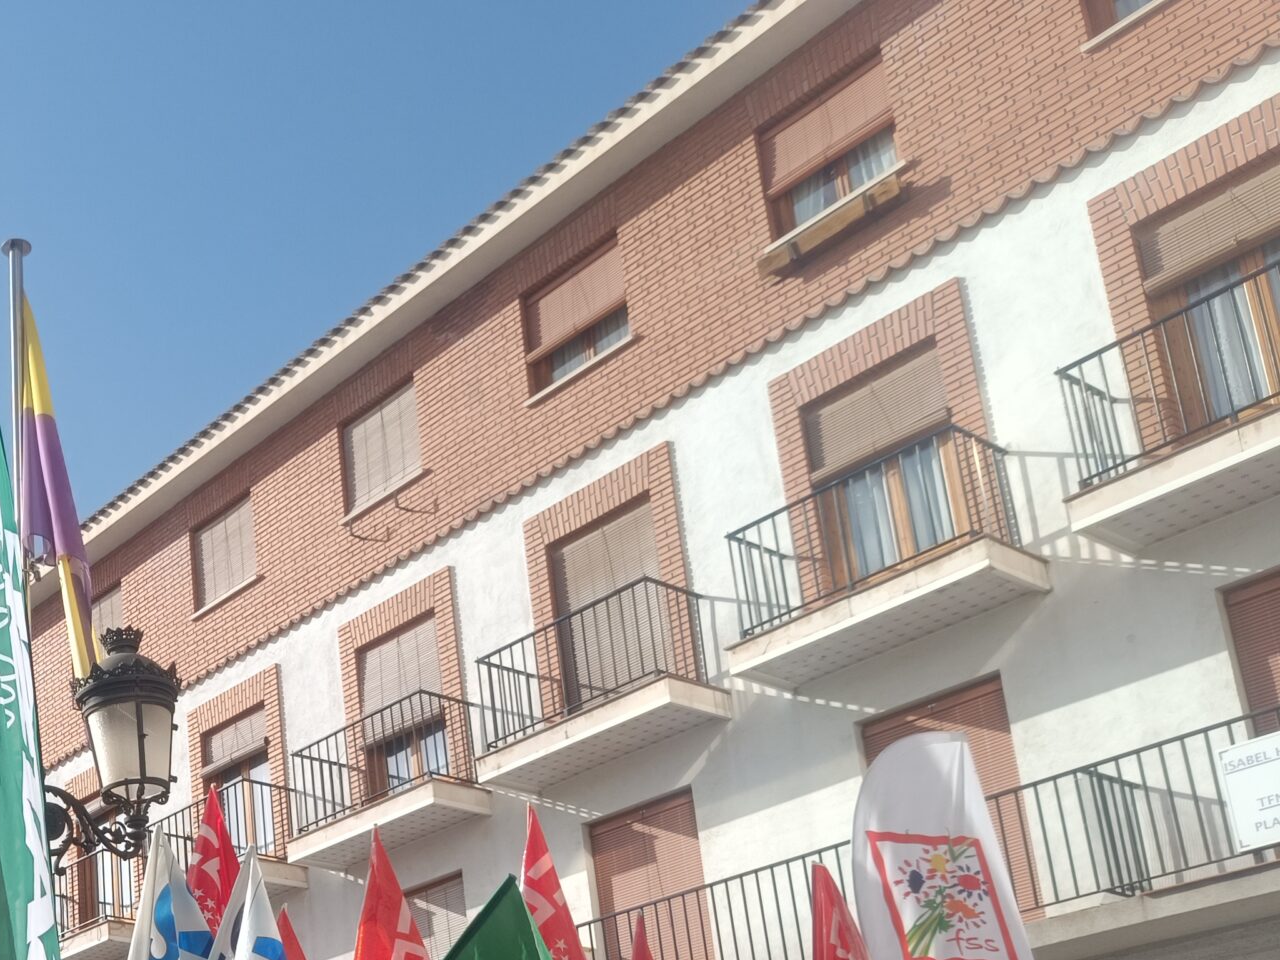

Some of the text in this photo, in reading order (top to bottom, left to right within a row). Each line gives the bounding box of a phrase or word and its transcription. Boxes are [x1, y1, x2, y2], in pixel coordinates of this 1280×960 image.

[1224, 751, 1272, 772] ISABEL
[1255, 817, 1280, 832] PLA
[945, 928, 1000, 956] fss
